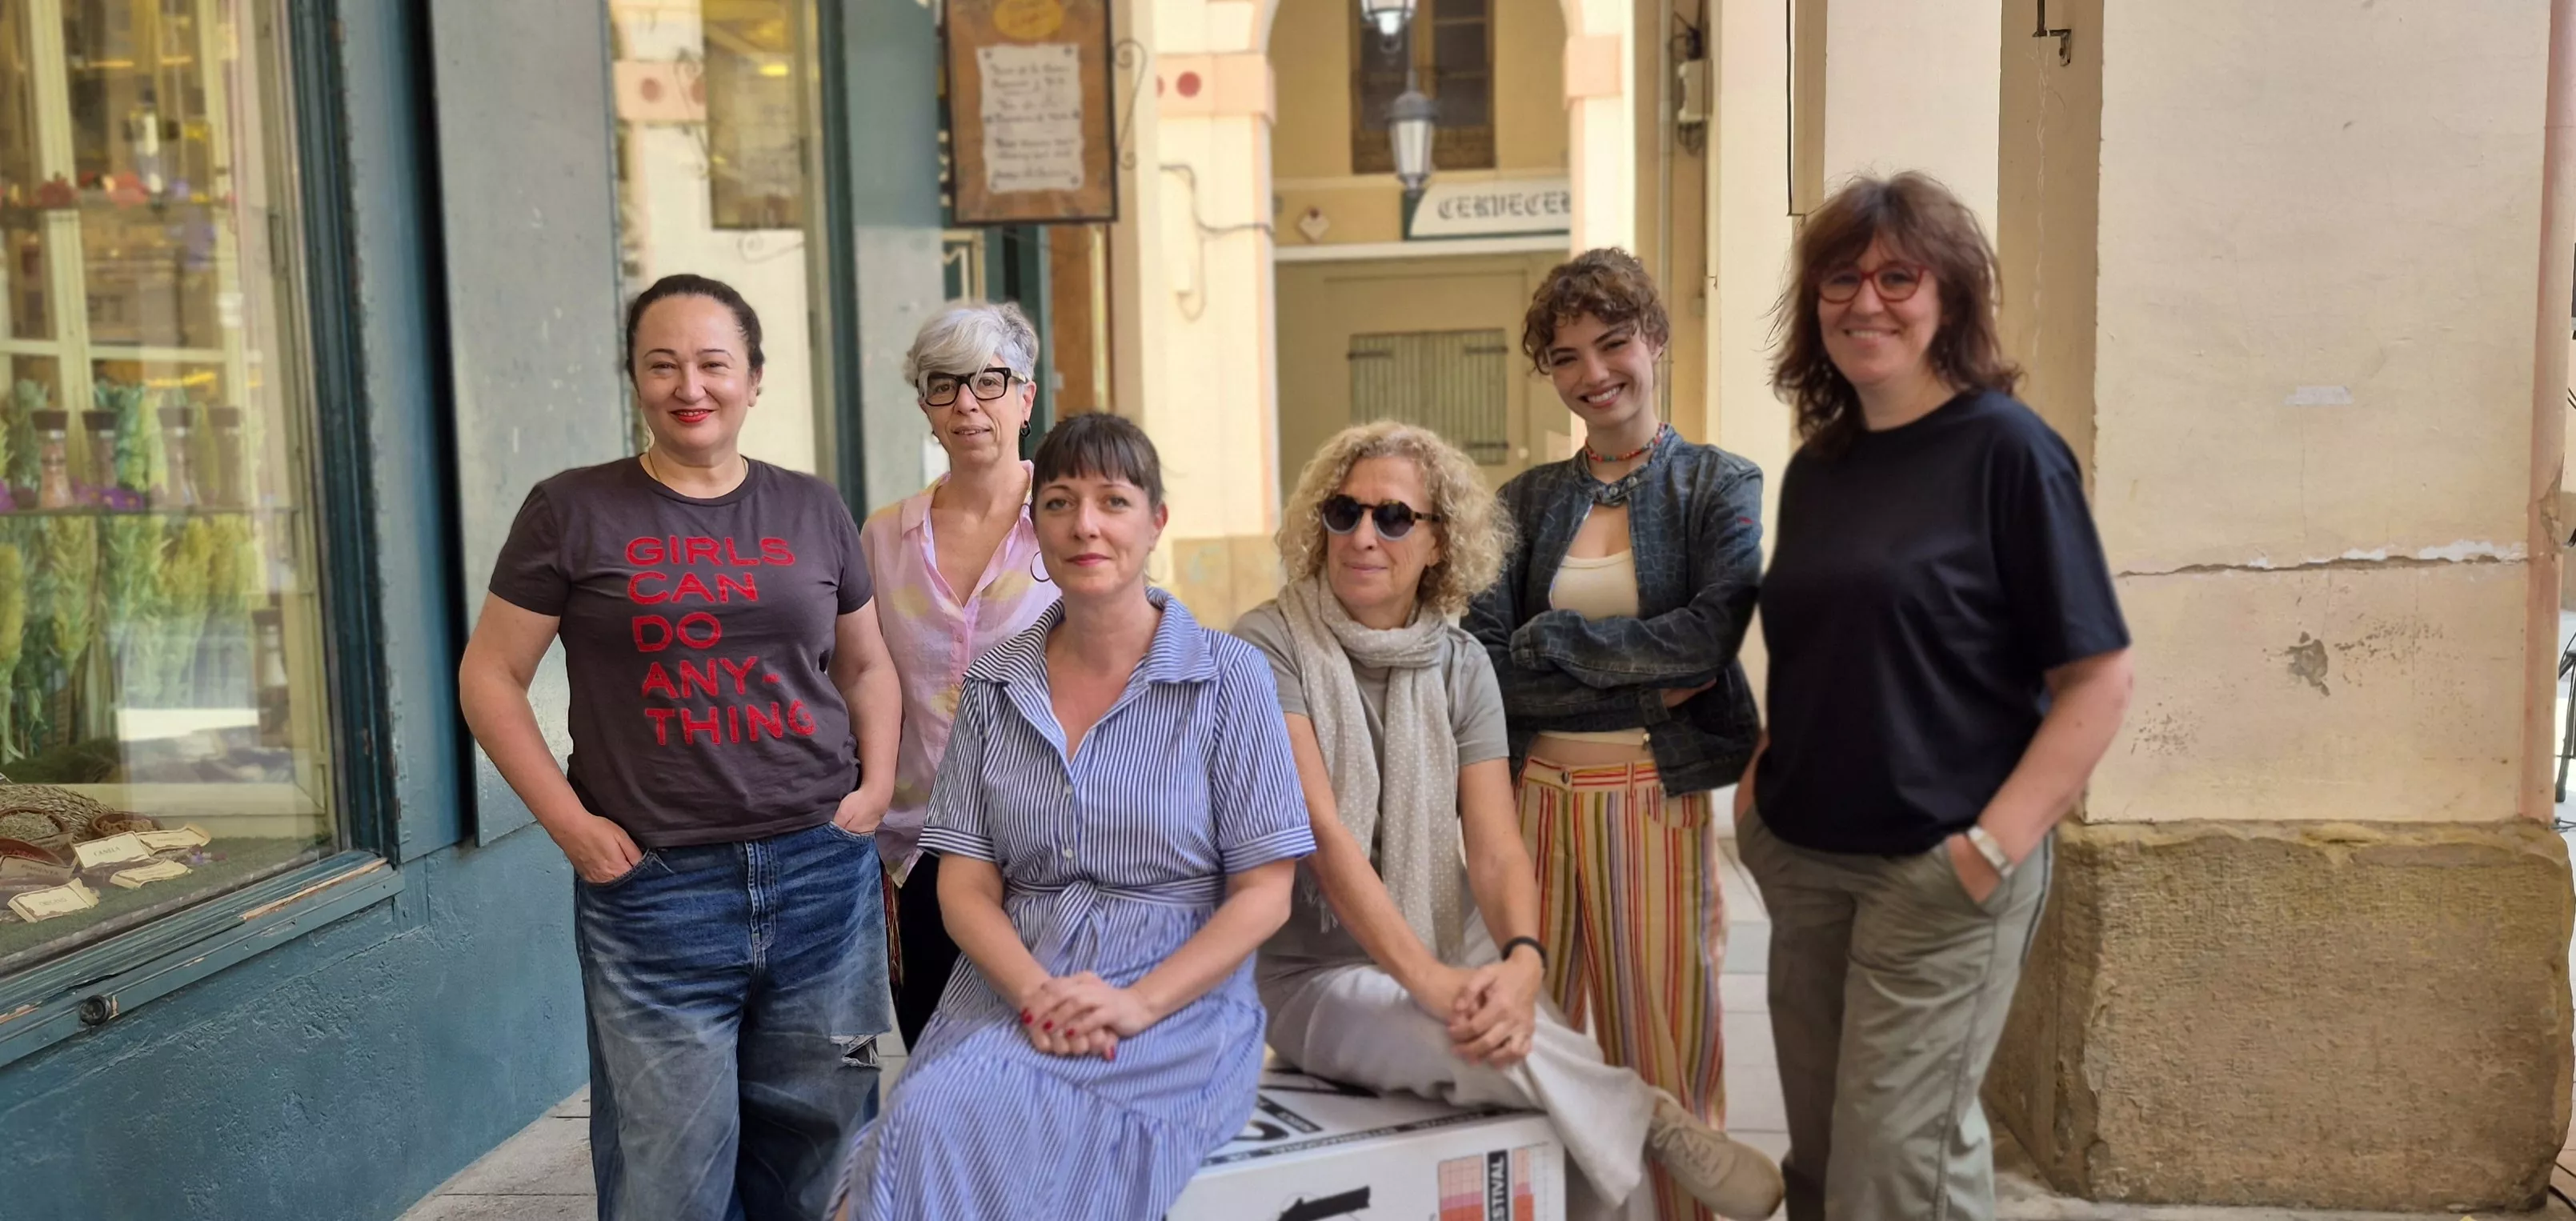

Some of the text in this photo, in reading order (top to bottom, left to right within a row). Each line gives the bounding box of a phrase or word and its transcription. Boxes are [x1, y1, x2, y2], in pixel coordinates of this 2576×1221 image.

[625, 535, 795, 566] GIRLS
[628, 570, 759, 605] CAN
[633, 612, 722, 651] DO
[643, 657, 779, 698] ANY-
[645, 700, 815, 745] THING
